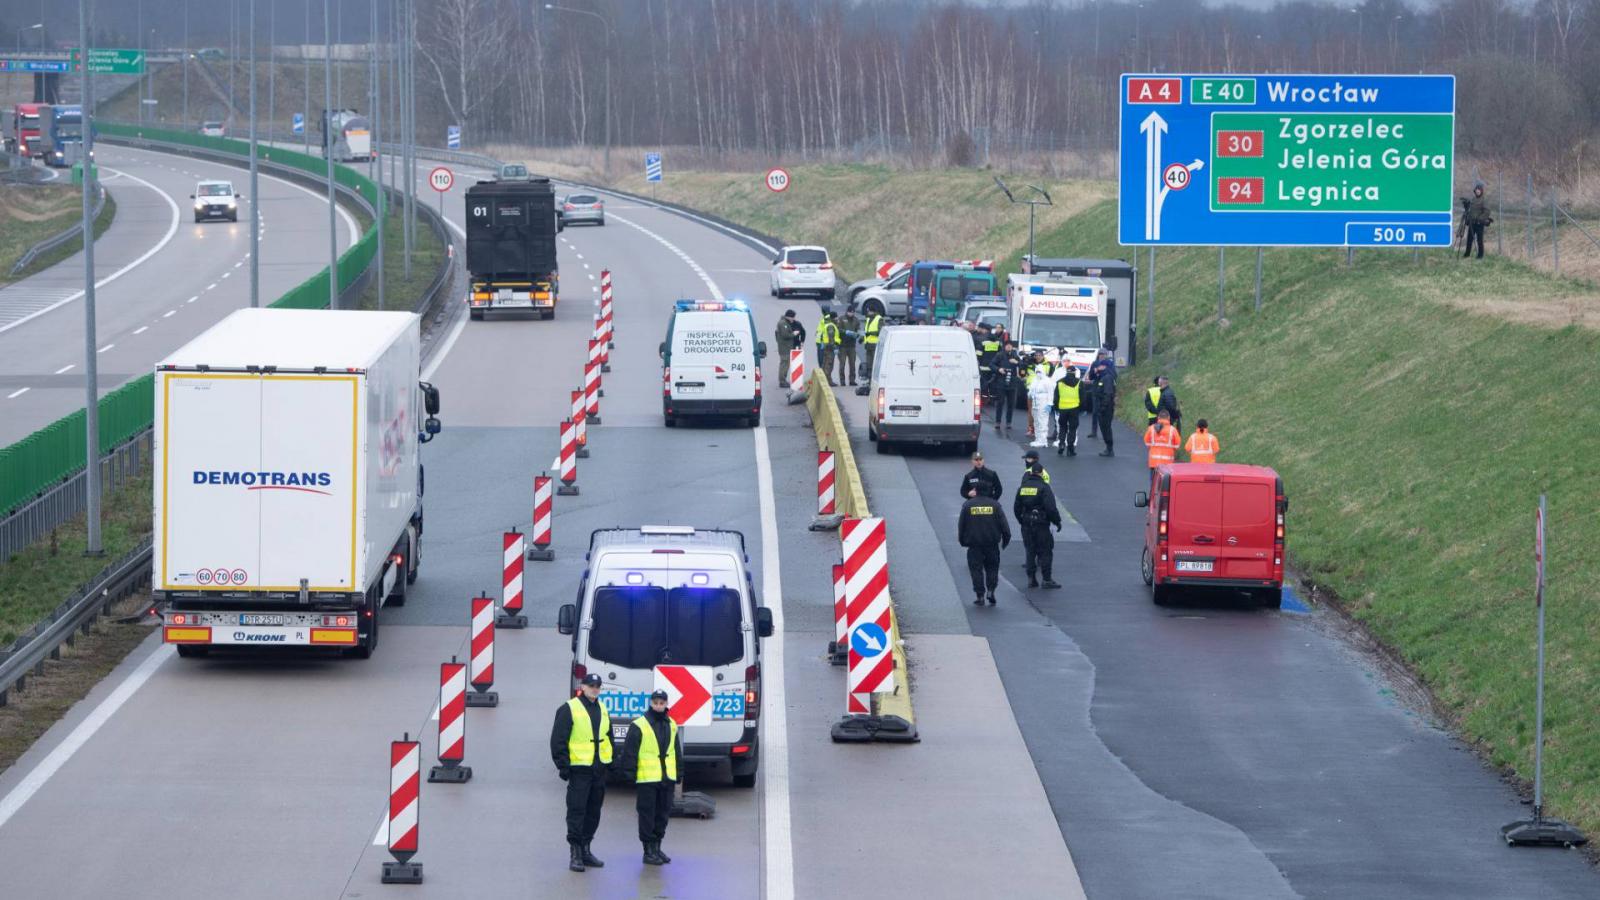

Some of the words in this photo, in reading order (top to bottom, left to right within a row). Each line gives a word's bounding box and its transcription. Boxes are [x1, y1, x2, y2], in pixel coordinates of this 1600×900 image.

[1139, 83, 1153, 99] A
[1159, 83, 1171, 99] 4
[1202, 84, 1212, 99] E
[1218, 83, 1244, 99] 40
[1267, 82, 1379, 103] Wrocław
[1279, 118, 1404, 144] Zgorzelec
[1228, 136, 1252, 152] 30
[1278, 149, 1372, 170] Jelenia
[1382, 148, 1446, 170] Góra
[434, 174, 450, 185] 110
[770, 175, 786, 185] 110
[1167, 170, 1187, 184] 40
[1229, 182, 1252, 199] 94
[1278, 180, 1380, 206] Legnica
[473, 207, 487, 217] 01
[1373, 228, 1405, 242] 500
[1413, 231, 1426, 242] m
[1030, 301, 1095, 312] AMBULANS
[731, 363, 746, 371] P40
[193, 471, 331, 486] DEMOTRANS
[199, 573, 211, 581] 60
[216, 573, 228, 581] 70
[233, 573, 245, 581] 80
[296, 631, 304, 640] PL
[598, 697, 652, 711] OLICJ
[712, 698, 741, 711] 723
